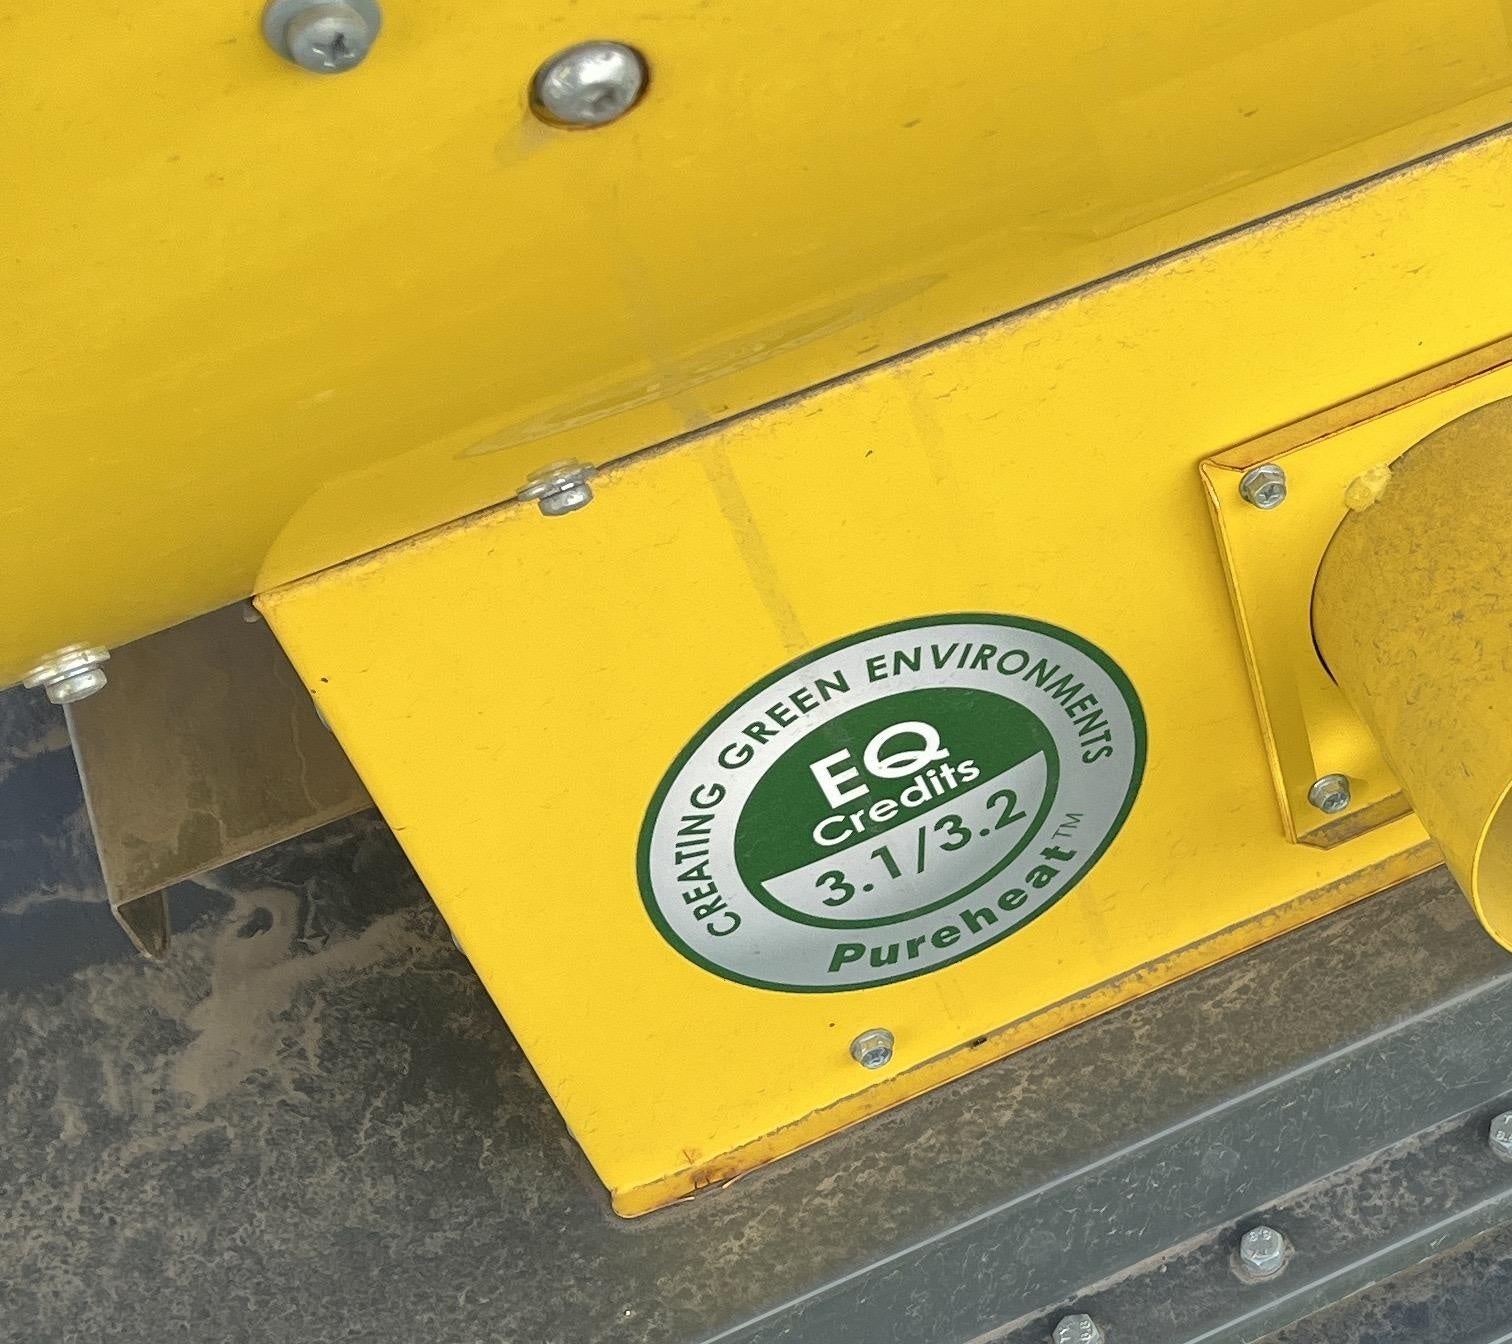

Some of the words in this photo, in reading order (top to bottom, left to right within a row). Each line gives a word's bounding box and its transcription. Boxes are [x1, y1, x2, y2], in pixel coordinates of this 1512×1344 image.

[674, 782, 742, 937] CREATING
[717, 669, 851, 770] GREEN
[865, 642, 1113, 764] ENVIRONMENTS
[809, 720, 951, 809] EQ
[812, 757, 981, 847] Credits
[814, 787, 1028, 907] 3.1/3.2
